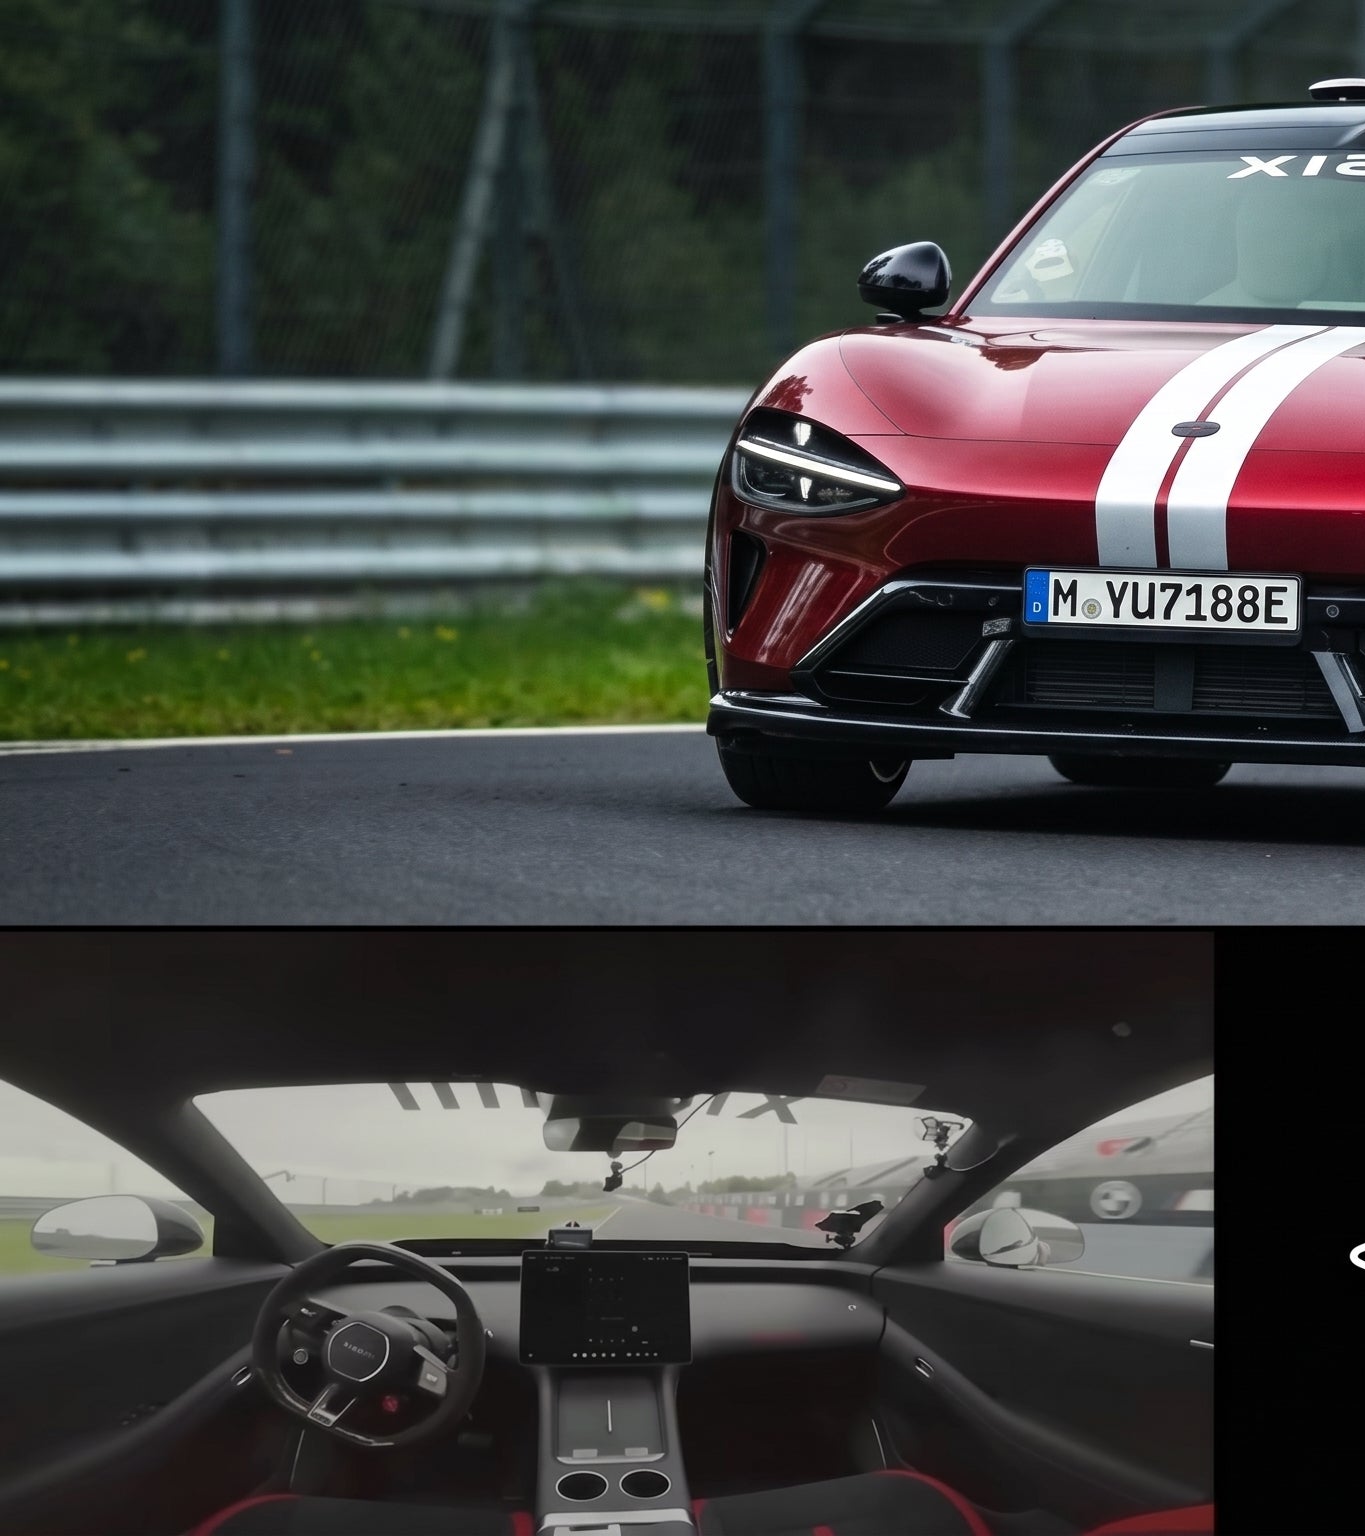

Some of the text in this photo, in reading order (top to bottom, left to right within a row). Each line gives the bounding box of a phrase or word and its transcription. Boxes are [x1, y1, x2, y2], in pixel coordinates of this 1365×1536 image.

[1033, 601, 1042, 613] D
[1053, 578, 1289, 625] M YU7188E
